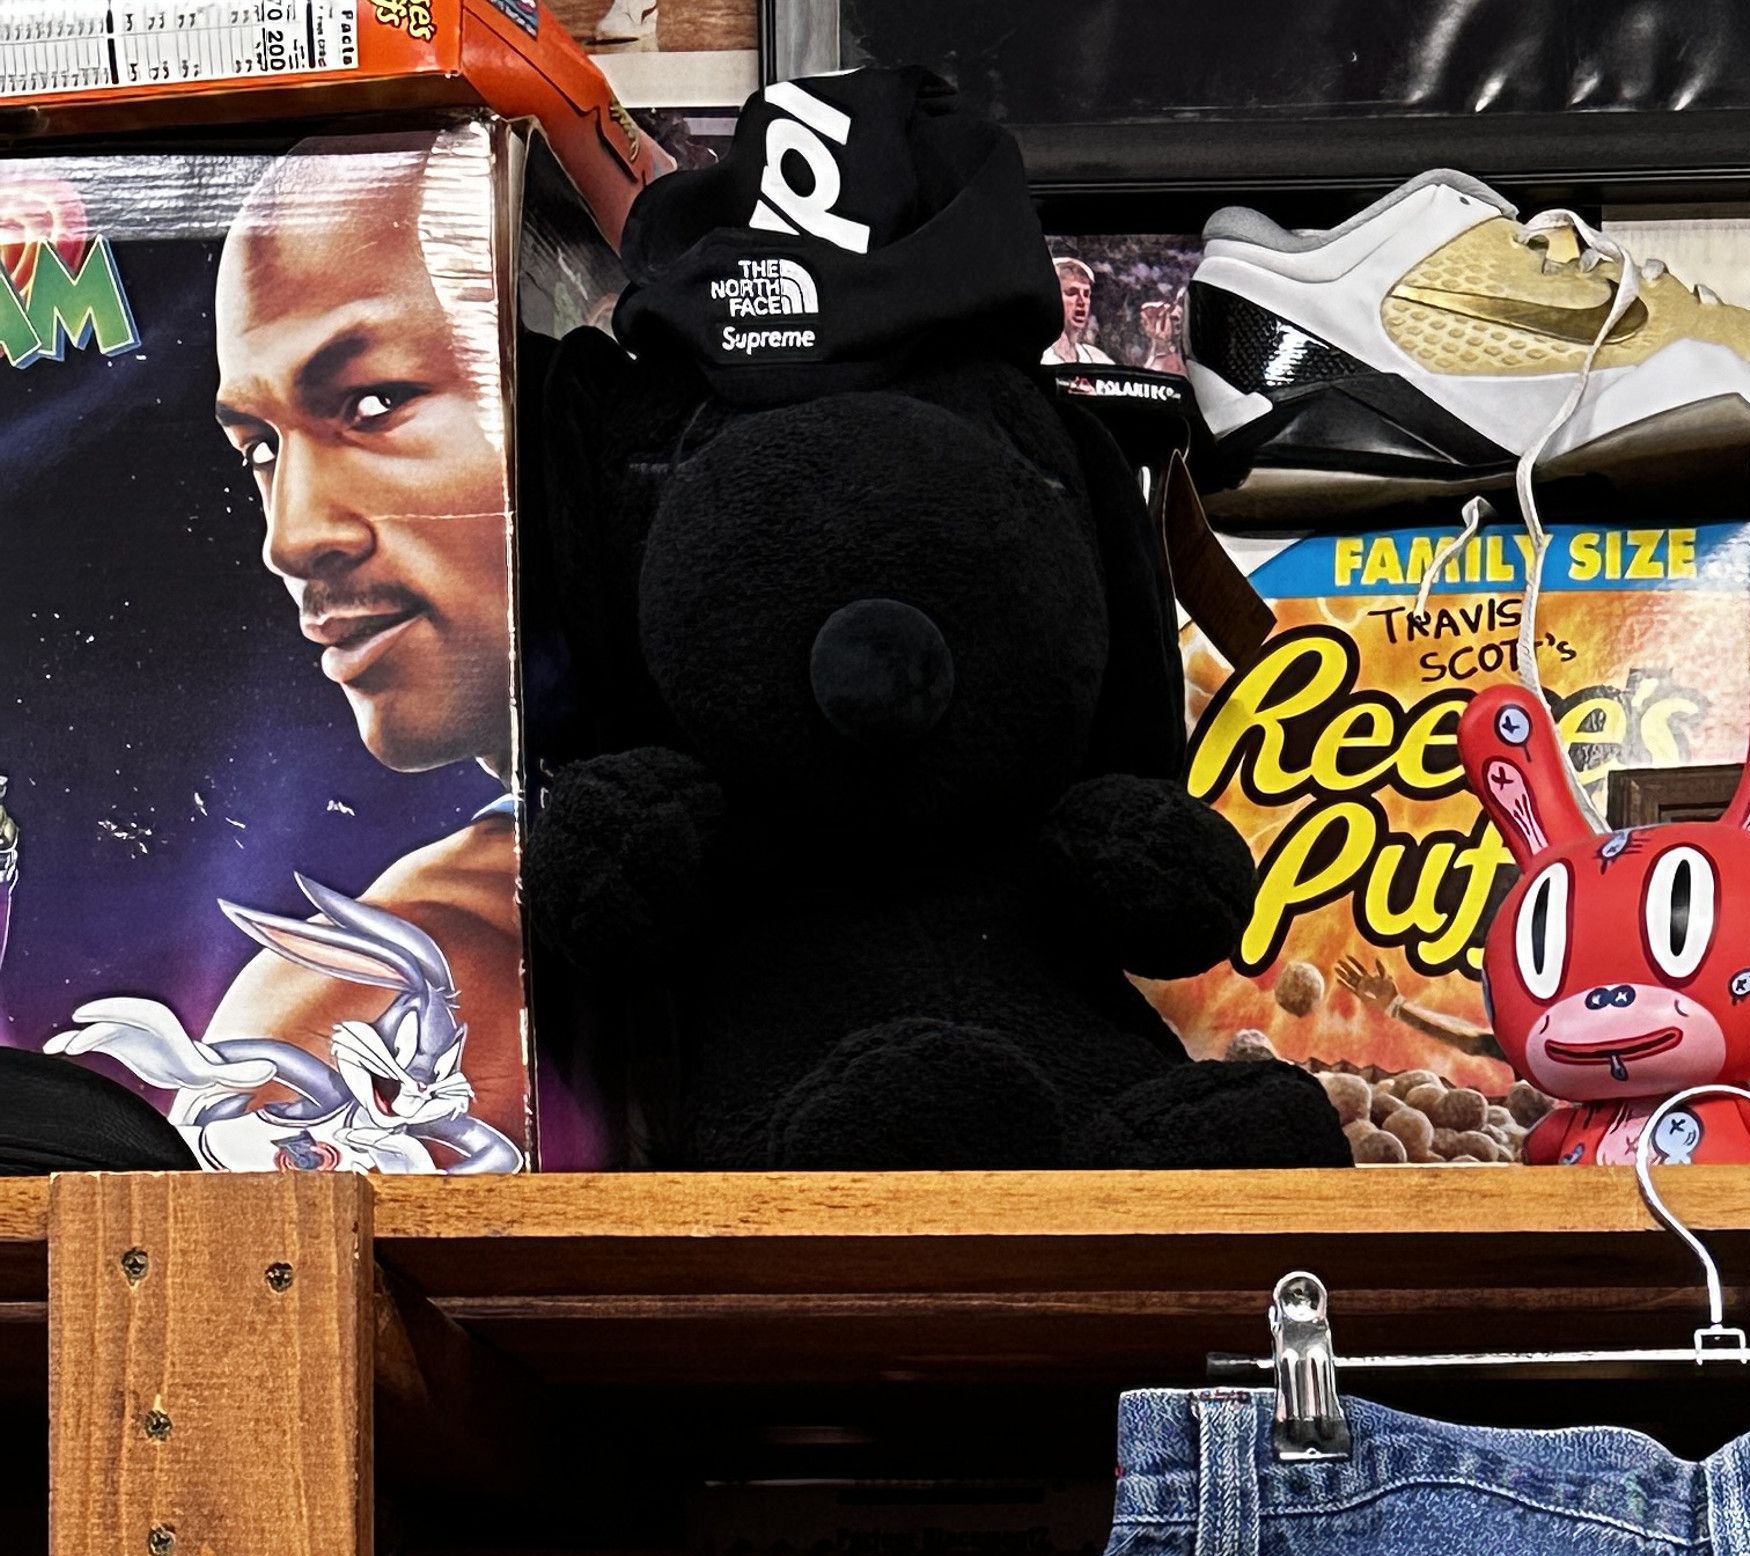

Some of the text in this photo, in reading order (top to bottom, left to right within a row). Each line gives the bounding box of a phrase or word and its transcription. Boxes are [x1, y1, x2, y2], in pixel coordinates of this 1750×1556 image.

[268, 30, 287, 71] 200
[738, 259, 780, 279] THE
[711, 277, 780, 299] NORTH
[729, 296, 782, 317] FACE
[721, 325, 816, 355] Supreme
[1334, 527, 1698, 588] FAMILY SIZE
[1368, 598, 1524, 645] TRAVIS
